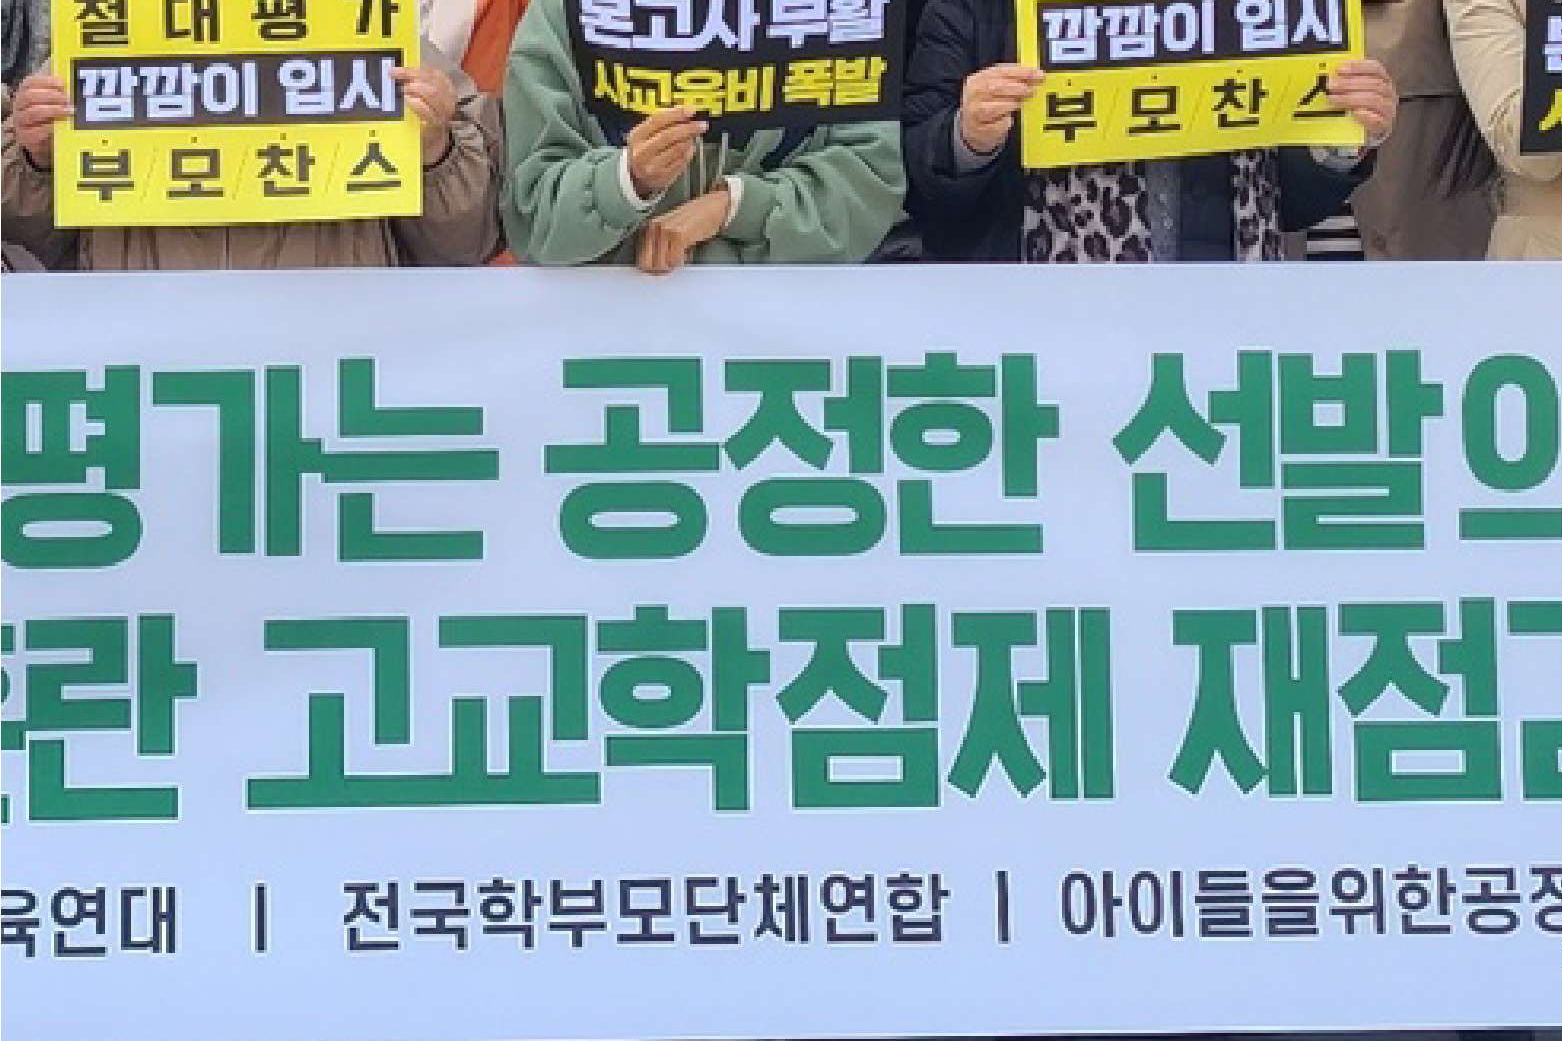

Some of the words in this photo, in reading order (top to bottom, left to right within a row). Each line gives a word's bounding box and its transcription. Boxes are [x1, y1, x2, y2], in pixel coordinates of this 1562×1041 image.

[1042, 0, 1216, 63] 깜깜이
[79, 60, 260, 122] 깜깜이
[277, 56, 398, 115] 입시
[594, 60, 776, 117] 사교육비
[783, 56, 888, 107] 폭발
[543, 352, 1059, 560] 공정한
[247, 601, 1114, 811] 고교학점제
[343, 871, 950, 952] 전국학부모단체연합
